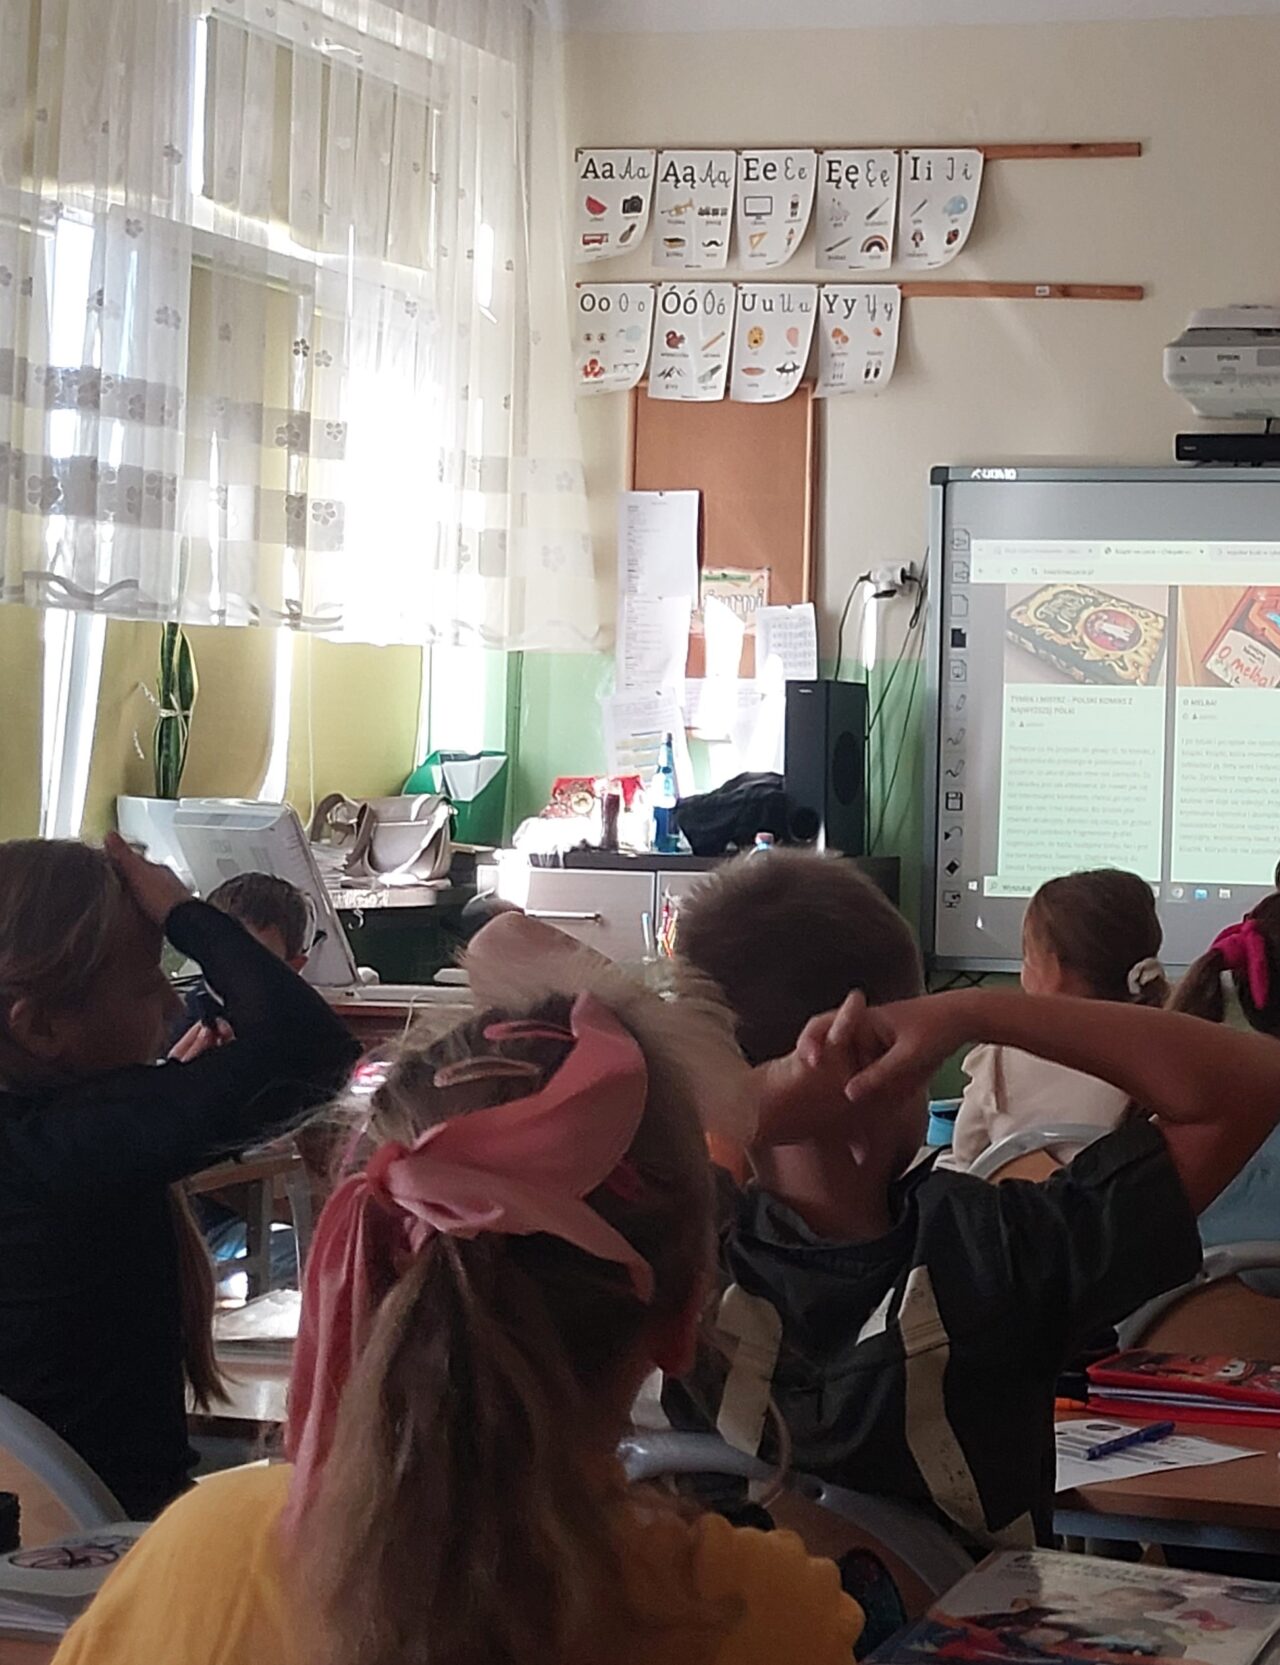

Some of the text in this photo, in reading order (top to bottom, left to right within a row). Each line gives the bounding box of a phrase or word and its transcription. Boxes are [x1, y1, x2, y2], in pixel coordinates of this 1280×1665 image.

[581, 158, 615, 180] Aa
[661, 160, 696, 188] Ąą
[744, 158, 777, 182] Ee
[826, 159, 859, 188] Ęę
[910, 157, 933, 182] Ii
[580, 294, 611, 312] Oo
[661, 286, 698, 315] Óó
[741, 293, 774, 313] Uu
[823, 294, 856, 319] Yy
